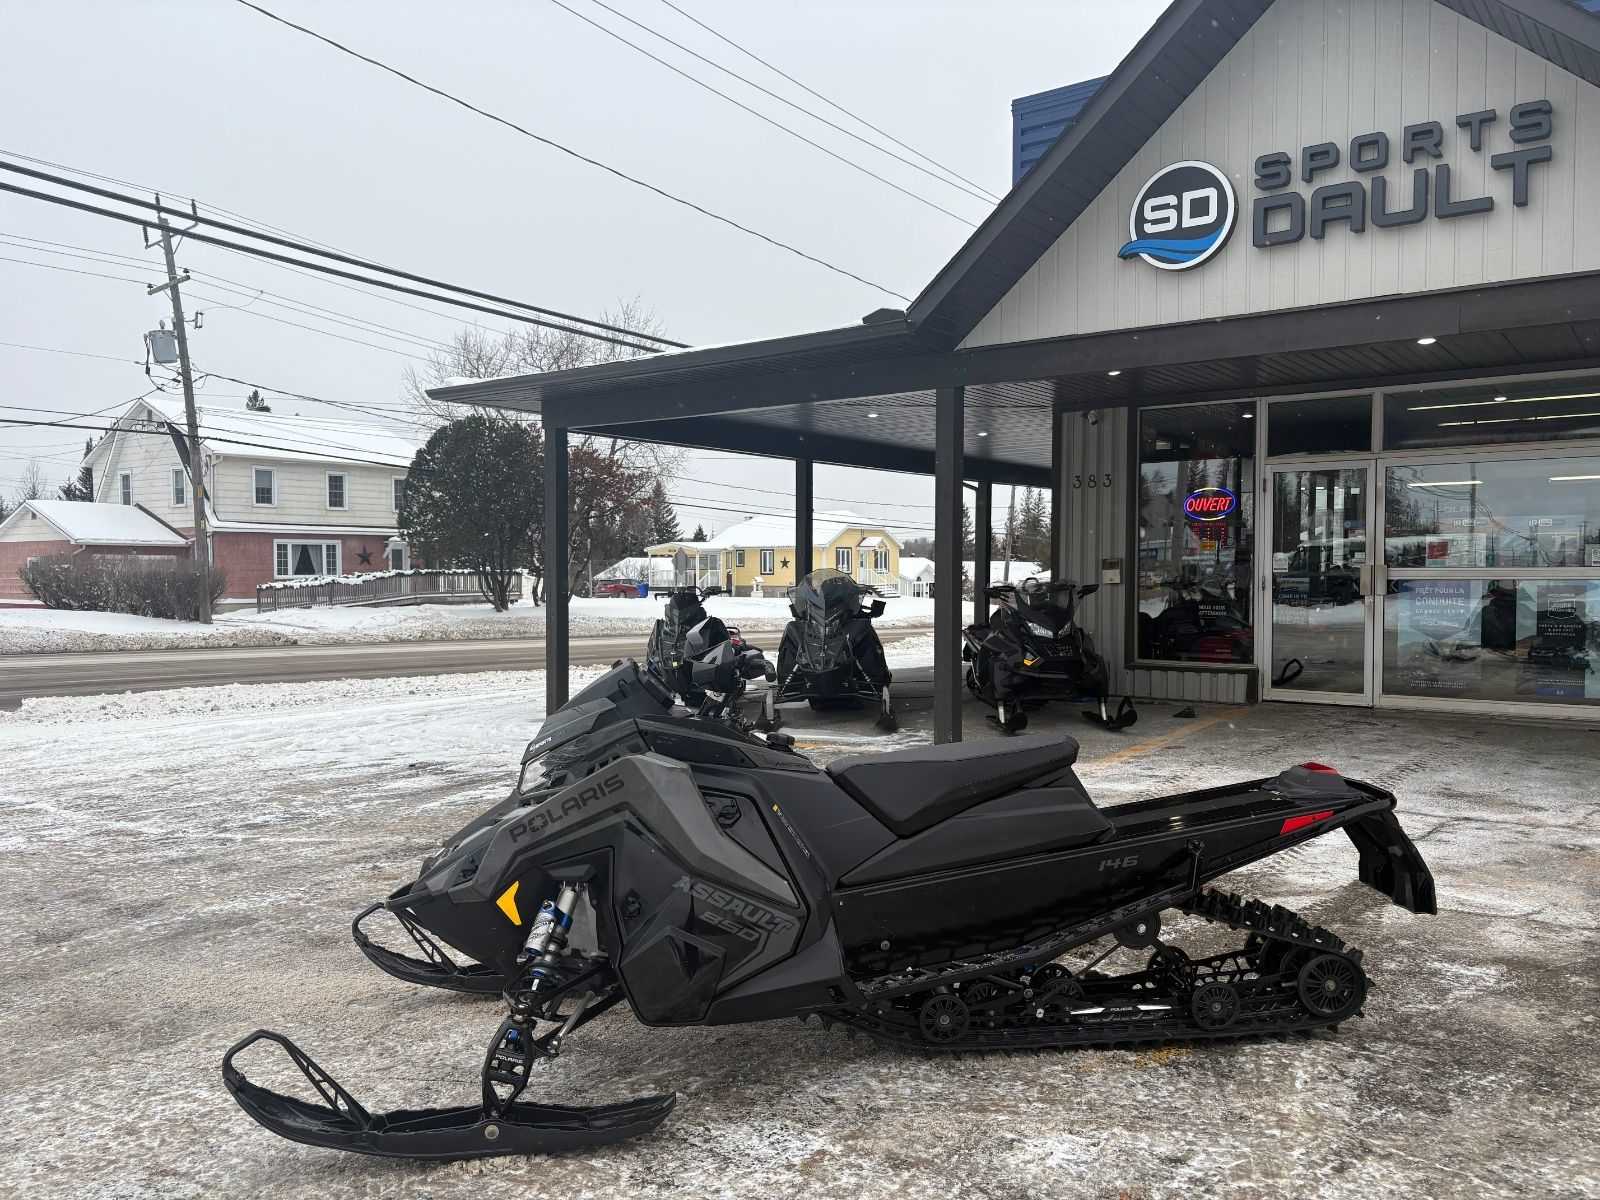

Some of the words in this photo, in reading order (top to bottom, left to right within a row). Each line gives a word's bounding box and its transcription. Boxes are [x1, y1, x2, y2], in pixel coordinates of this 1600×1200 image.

[1254, 99, 1553, 191] SPORTS
[1143, 186, 1218, 234] SD
[1252, 145, 1553, 248] DAULT
[1073, 474, 1112, 489] 383
[1186, 497, 1232, 512] OUVERT
[1415, 596, 1465, 606] CONDUITE
[509, 774, 625, 843] POLARIS
[1098, 855, 1139, 872] 146
[671, 875, 797, 935] ASSAULT
[697, 911, 761, 942] 850
